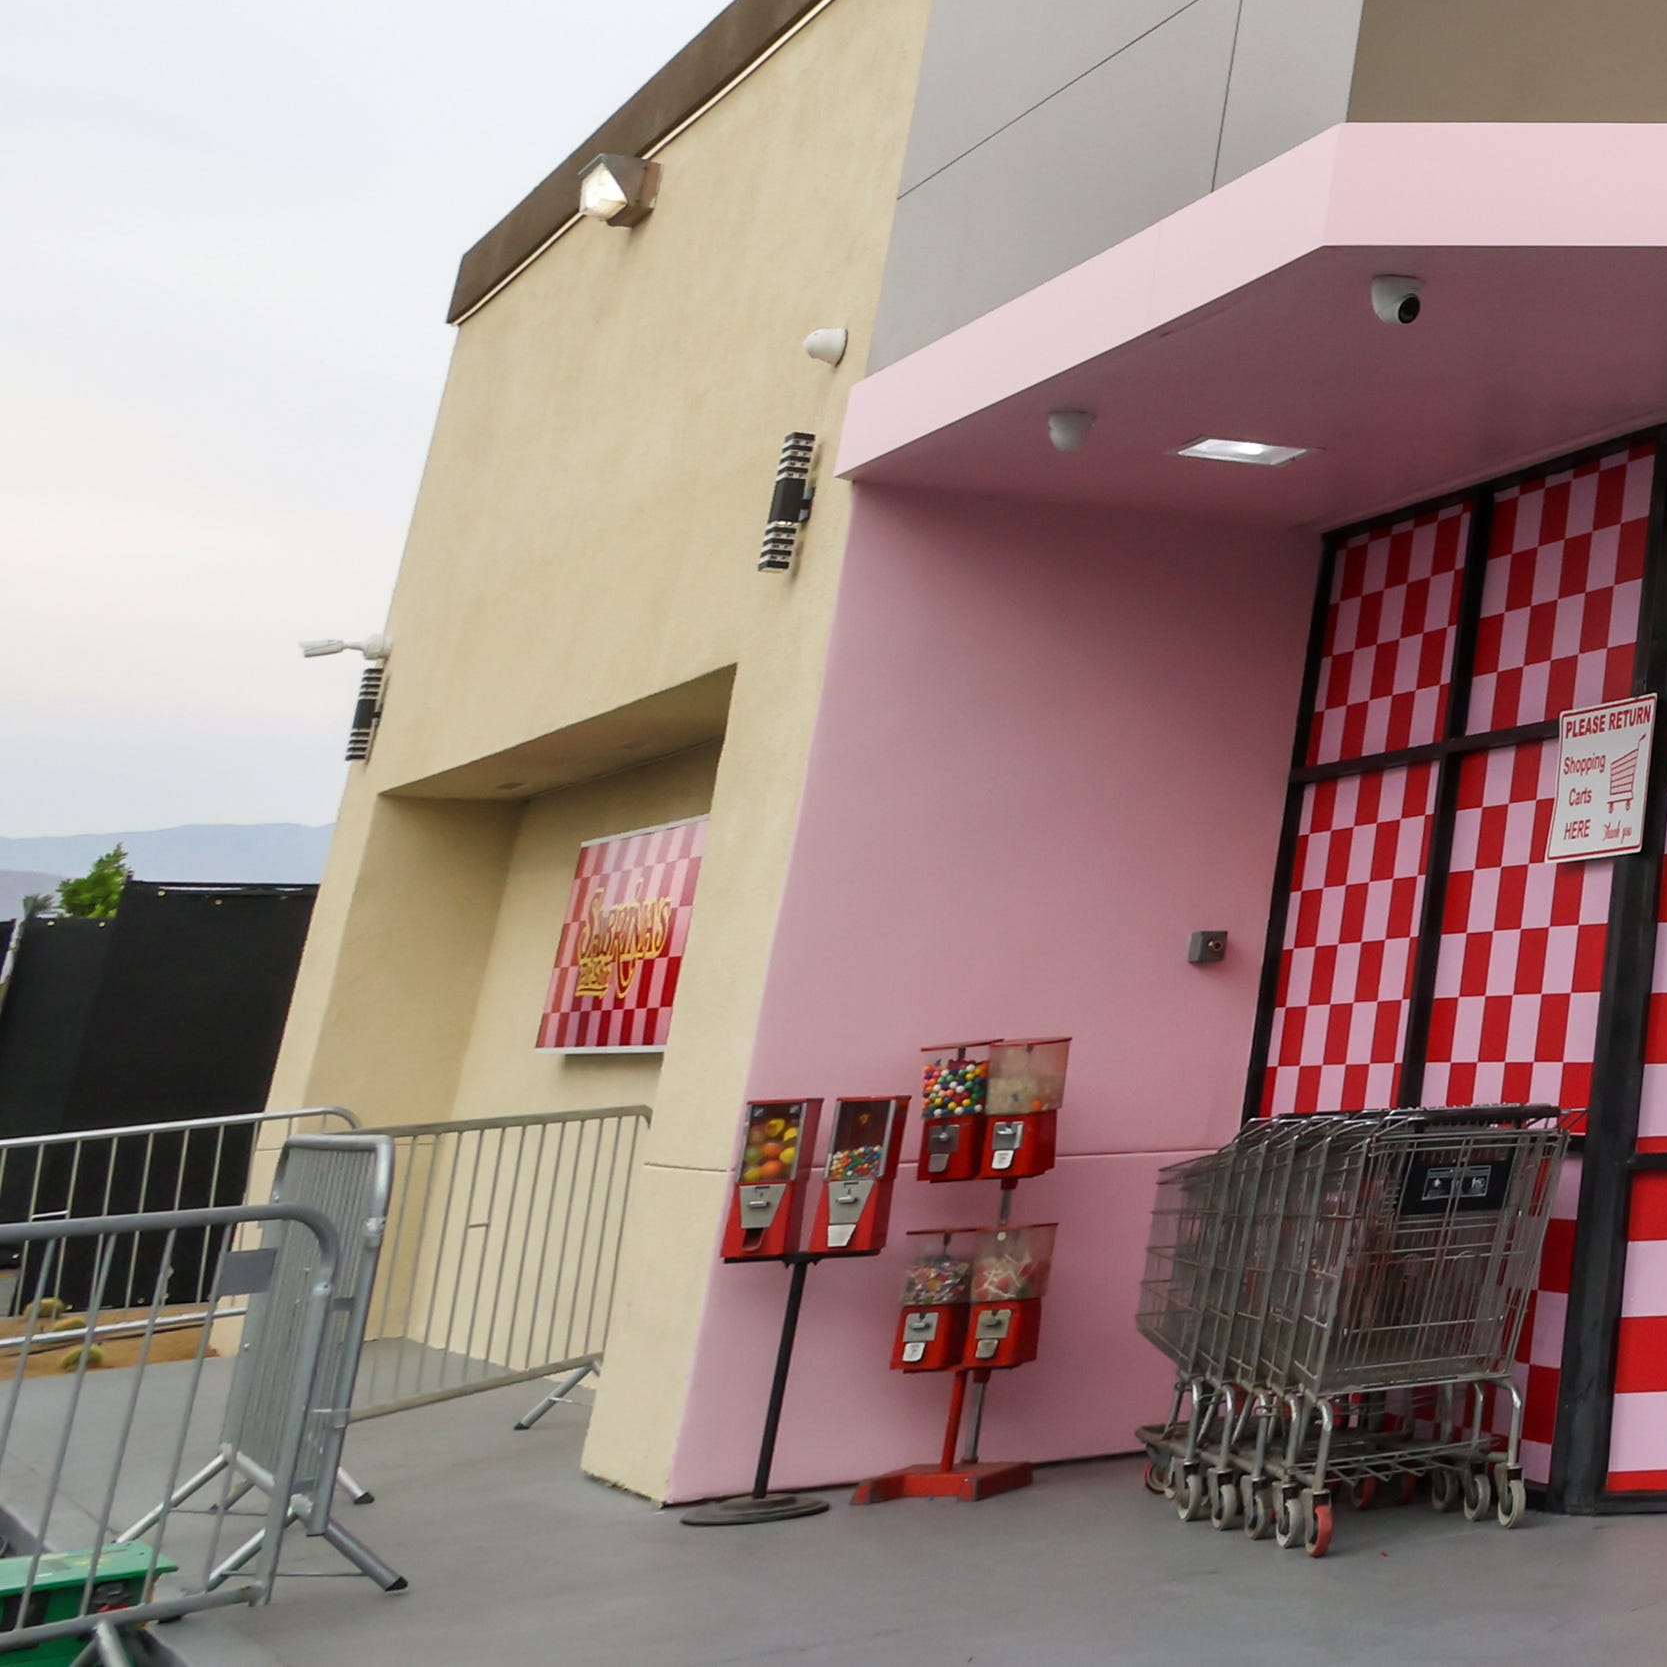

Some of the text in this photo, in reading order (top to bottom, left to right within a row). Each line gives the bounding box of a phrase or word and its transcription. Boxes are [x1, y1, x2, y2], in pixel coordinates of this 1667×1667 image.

[1566, 705, 1651, 738] PLEASE RETURN
[1564, 753, 1605, 776] Shopping
[1569, 788, 1591, 806] Carts
[1564, 819, 1590, 840] HERE
